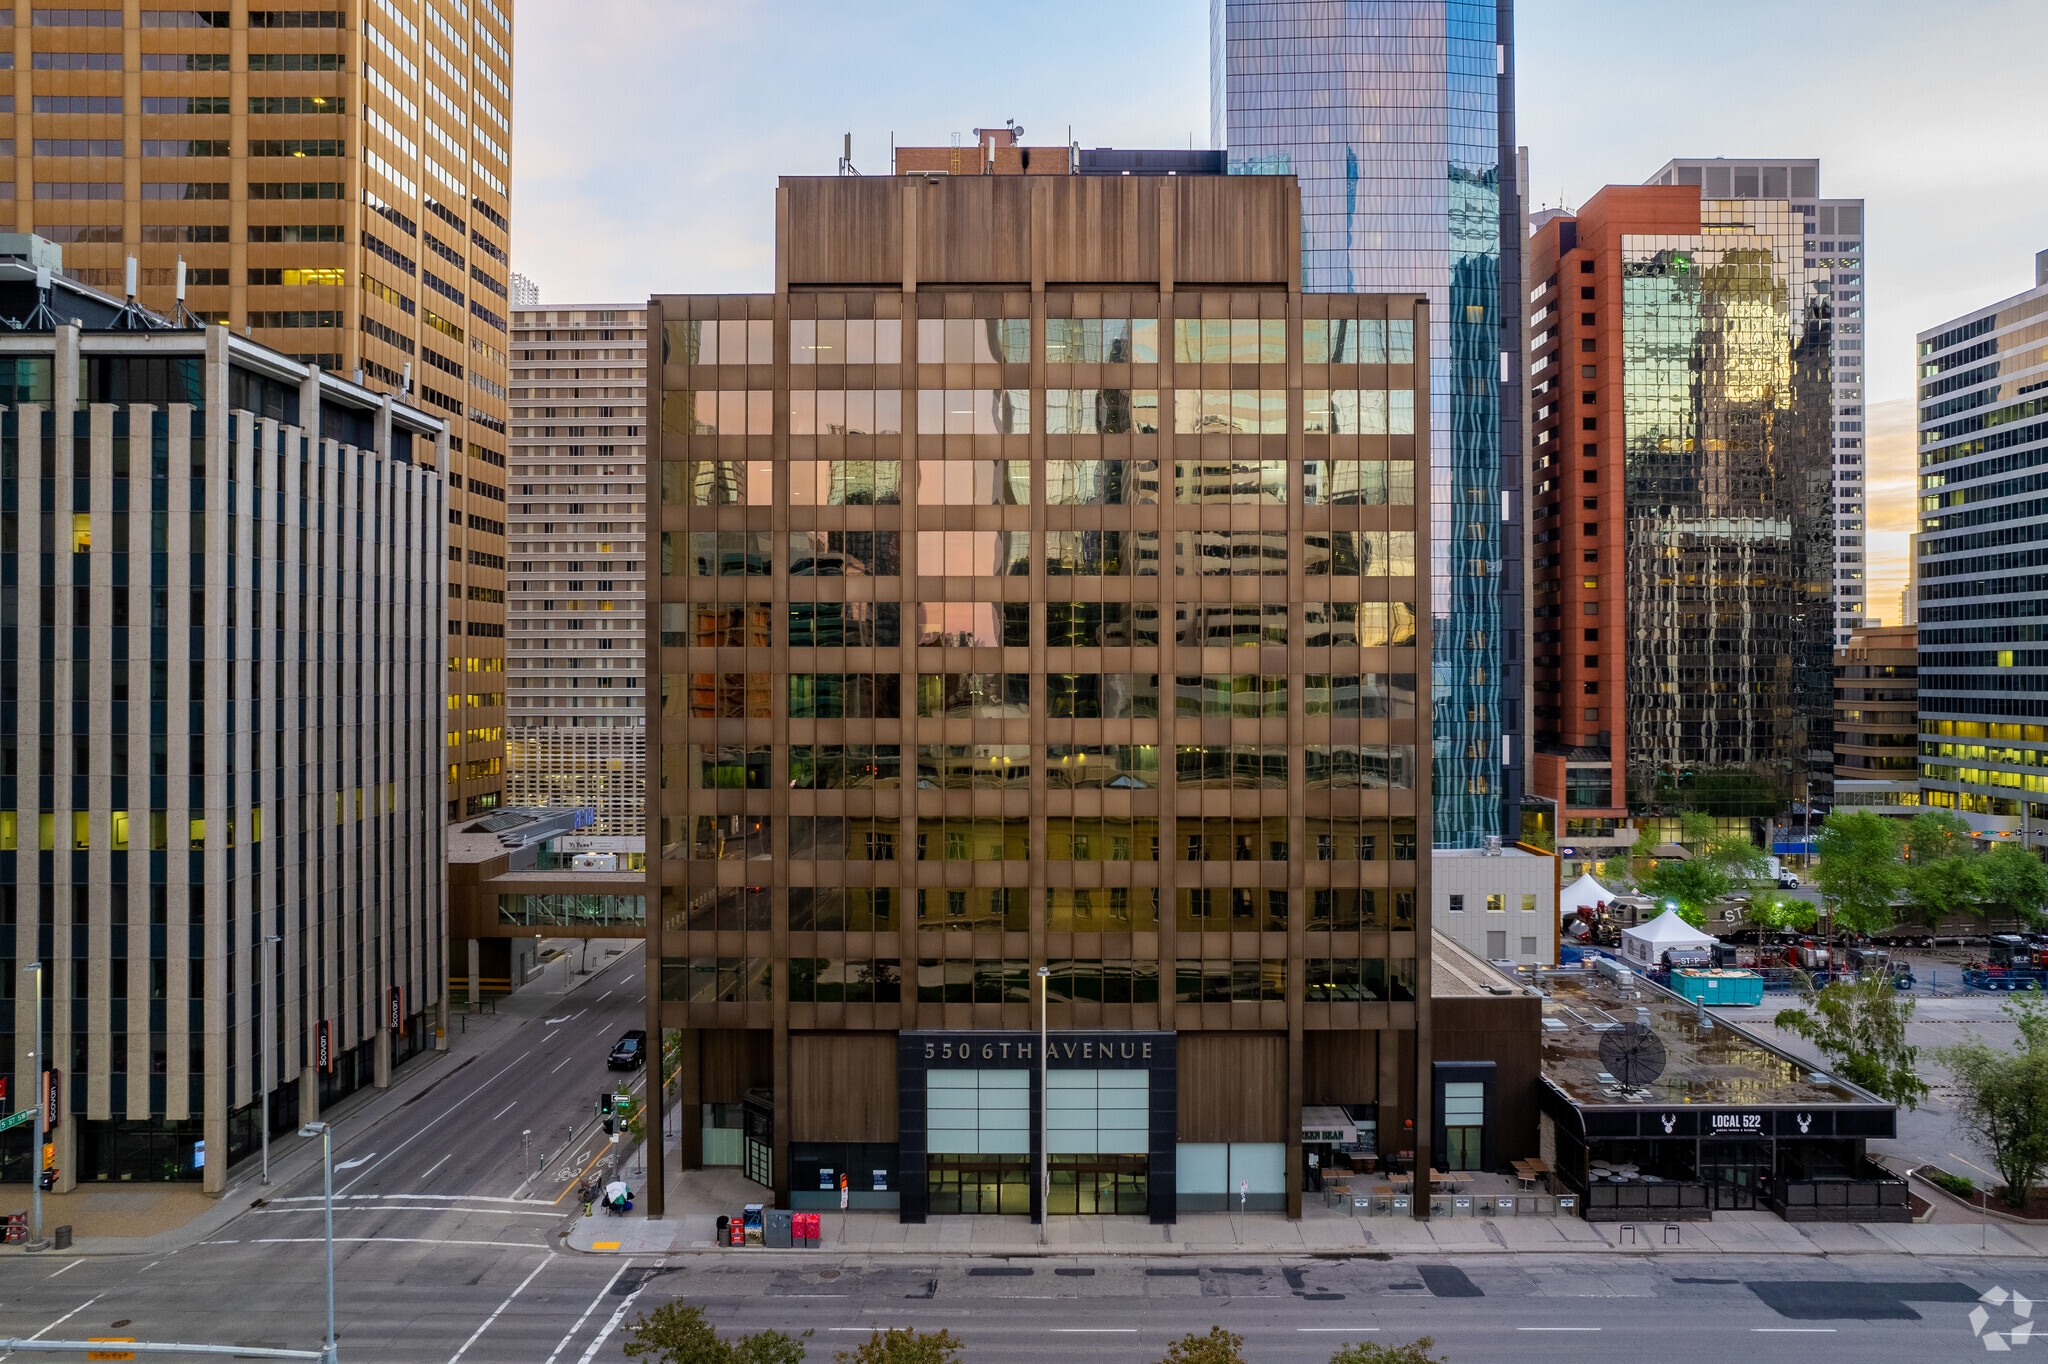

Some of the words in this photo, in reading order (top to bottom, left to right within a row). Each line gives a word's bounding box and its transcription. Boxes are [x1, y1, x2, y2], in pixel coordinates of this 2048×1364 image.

[391, 1000, 399, 1028] Scovan
[319, 1035, 327, 1066] Scovan
[924, 1043, 971, 1059] 550
[982, 1043, 1032, 1059] 6TH
[1046, 1042, 1152, 1059] AVENUE
[8, 1117, 15, 1126] ST
[17, 1113, 26, 1121] SW
[1712, 1114, 1741, 1128] LOCAL
[1742, 1114, 1761, 1128] 522
[1302, 1130, 1321, 1140] REEN
[1322, 1130, 1344, 1140] BEAN
